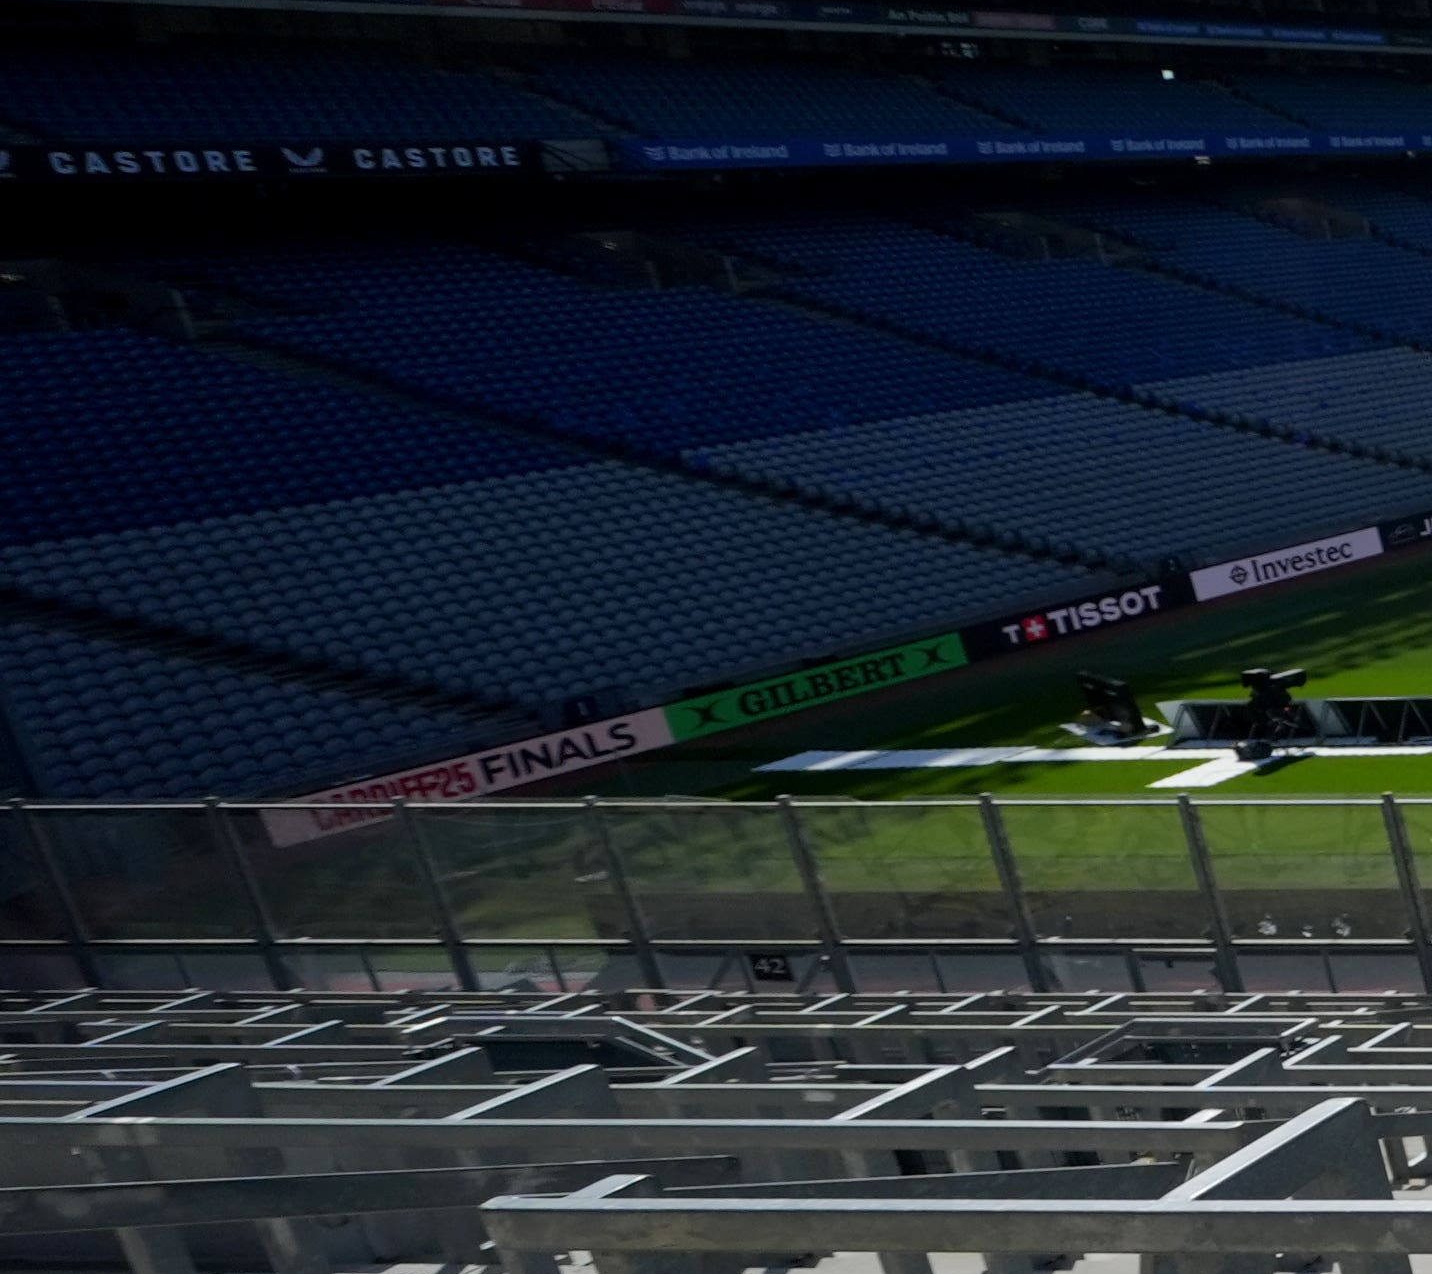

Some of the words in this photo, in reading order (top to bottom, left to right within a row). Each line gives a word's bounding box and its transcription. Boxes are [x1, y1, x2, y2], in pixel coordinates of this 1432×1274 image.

[49, 150, 257, 175] CASTORE
[352, 146, 522, 170] CASTORE
[667, 145, 711, 161] Bank
[712, 146, 729, 160] of
[730, 145, 790, 159] Ireland
[1252, 540, 1353, 583] Investec
[1047, 584, 1162, 636] TISSOT
[738, 653, 907, 719] GILBERT
[480, 723, 636, 789] FINALS
[754, 958, 785, 974] 42
